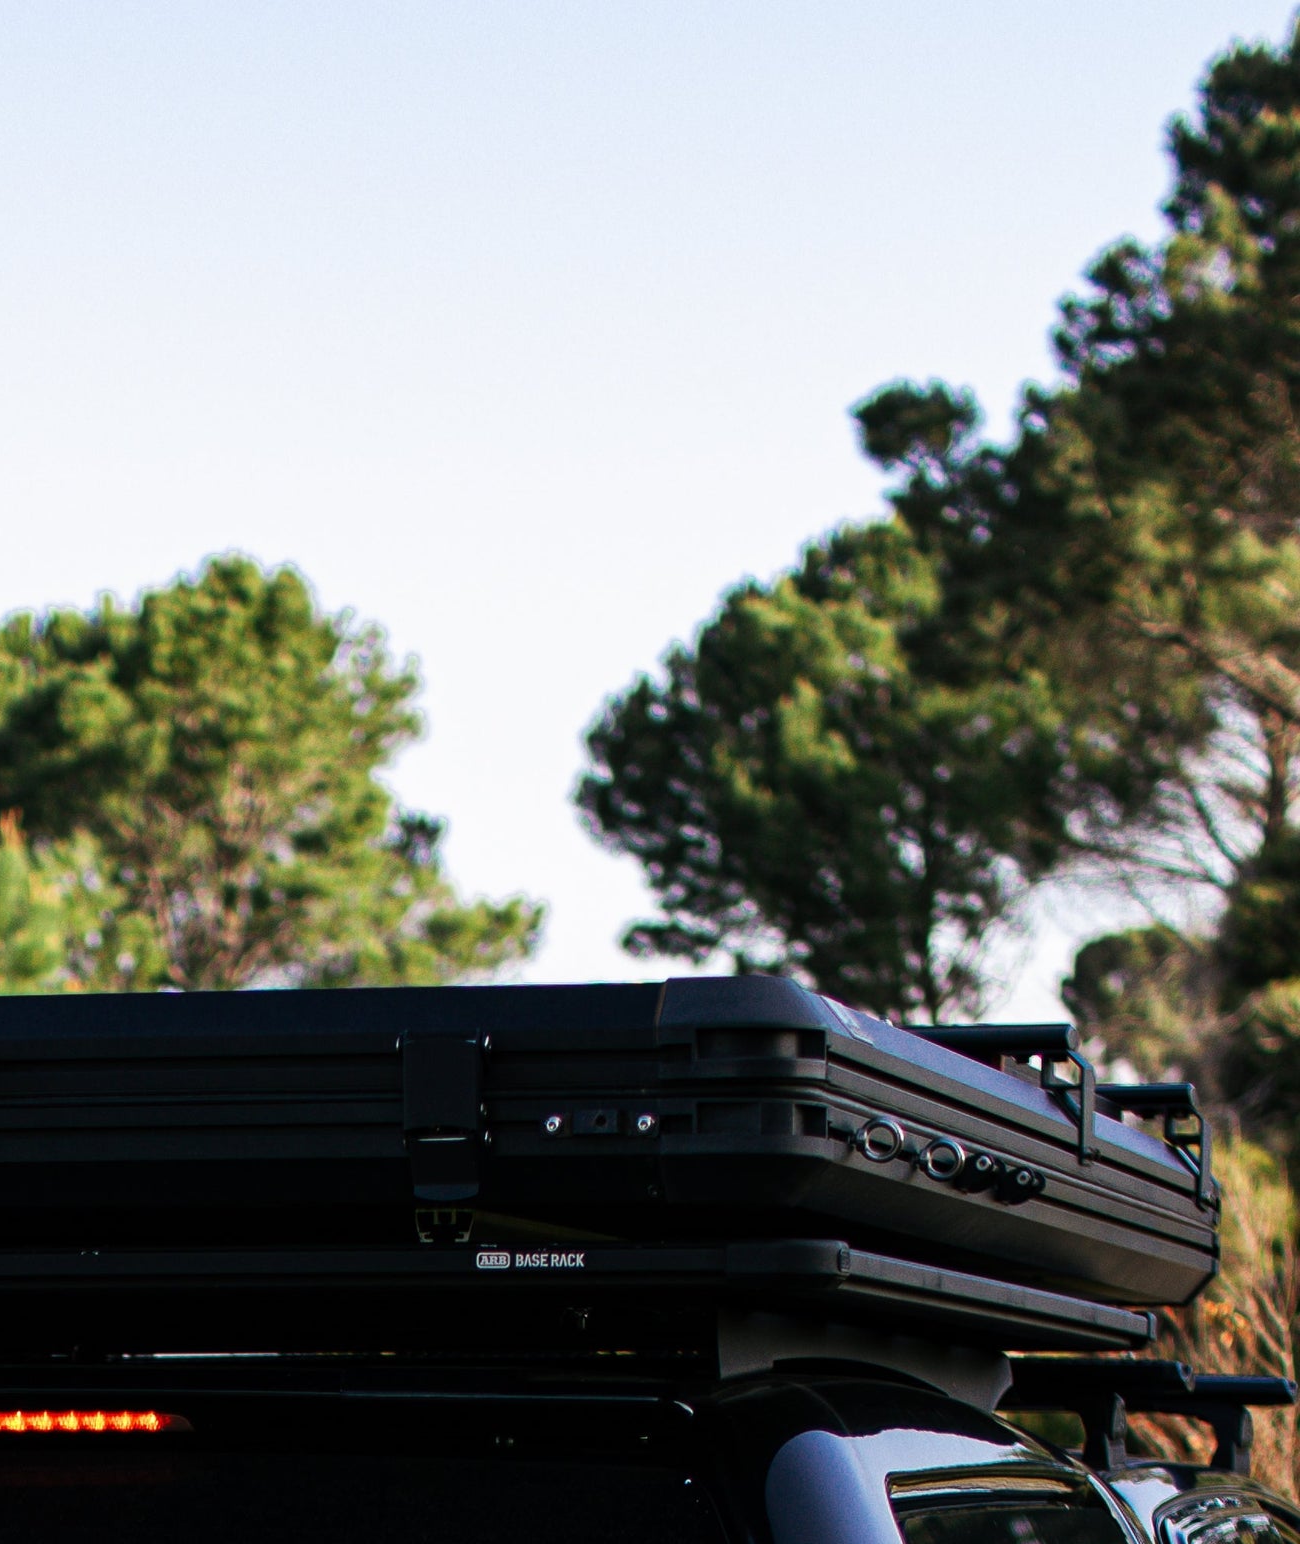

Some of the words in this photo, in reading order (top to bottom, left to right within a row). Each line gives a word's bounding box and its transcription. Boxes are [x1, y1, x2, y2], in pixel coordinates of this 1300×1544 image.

[479, 1254, 509, 1267] ARB
[515, 1253, 549, 1267] BASE
[551, 1253, 585, 1267] RACK
